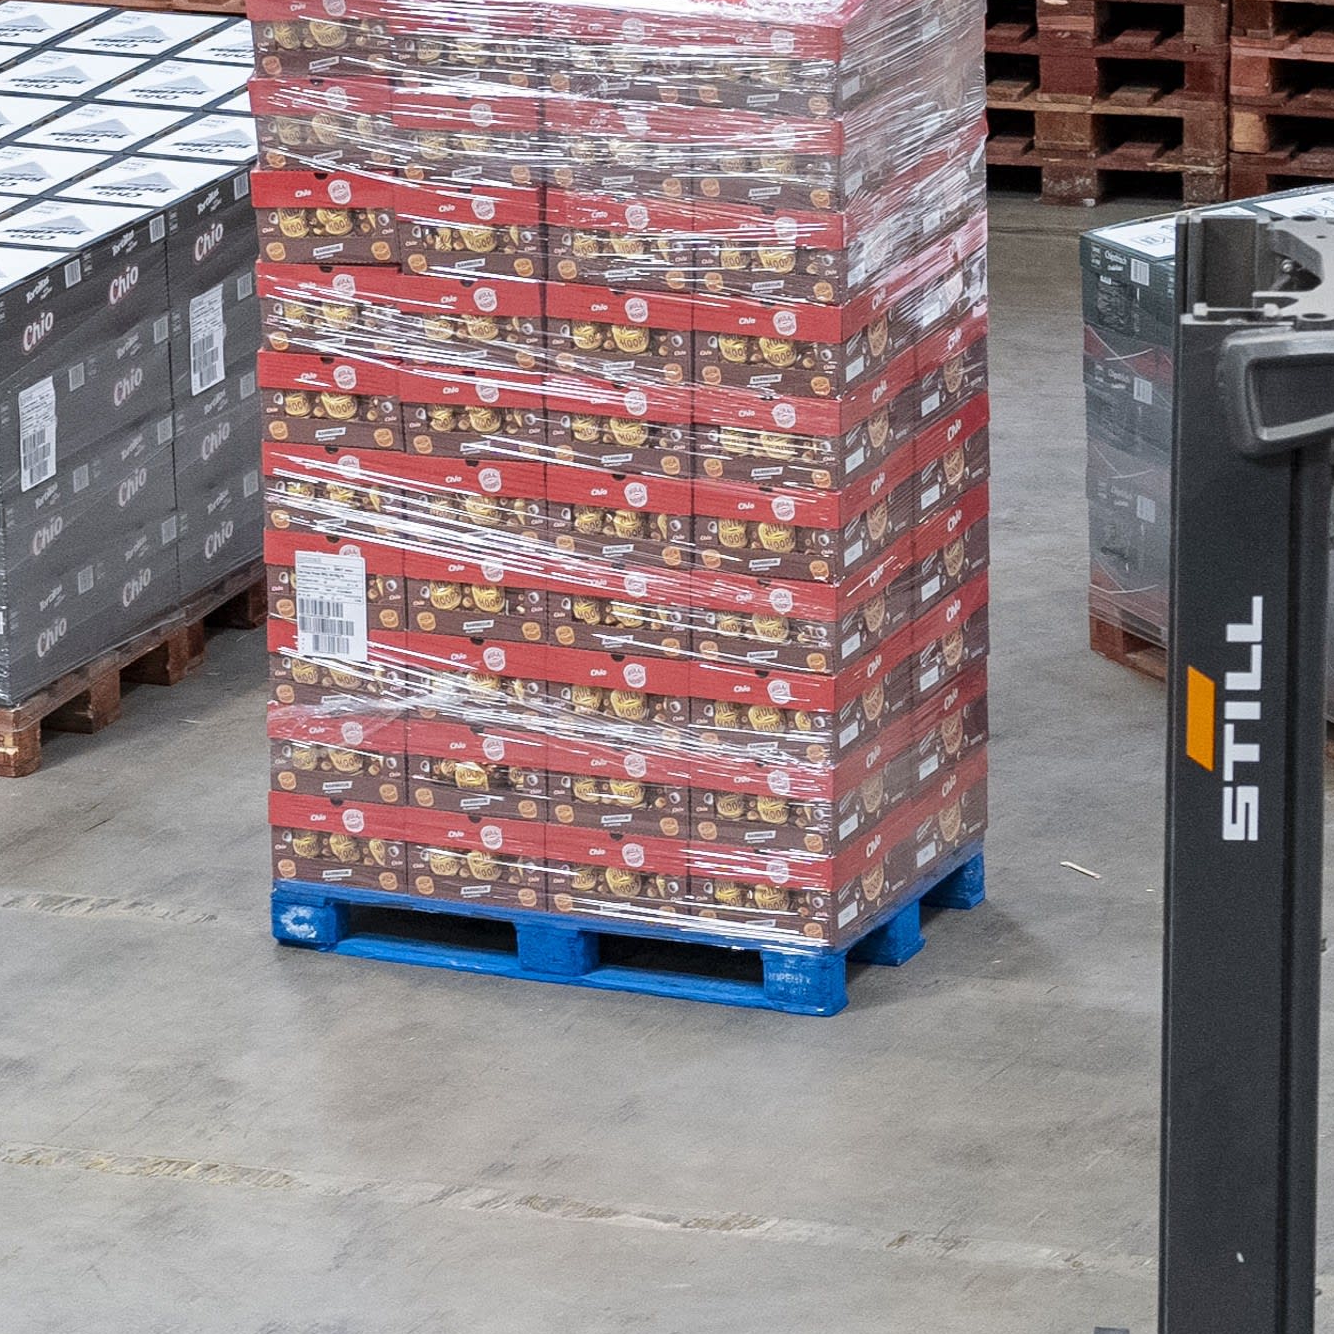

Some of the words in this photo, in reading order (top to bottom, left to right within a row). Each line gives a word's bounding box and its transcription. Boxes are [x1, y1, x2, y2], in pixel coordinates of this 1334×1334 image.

[195, 223, 223, 261] Chio
[109, 266, 139, 305] Chio
[23, 312, 53, 351] Chio
[205, 521, 233, 559] Chio
[1223, 596, 1263, 841] STILL
